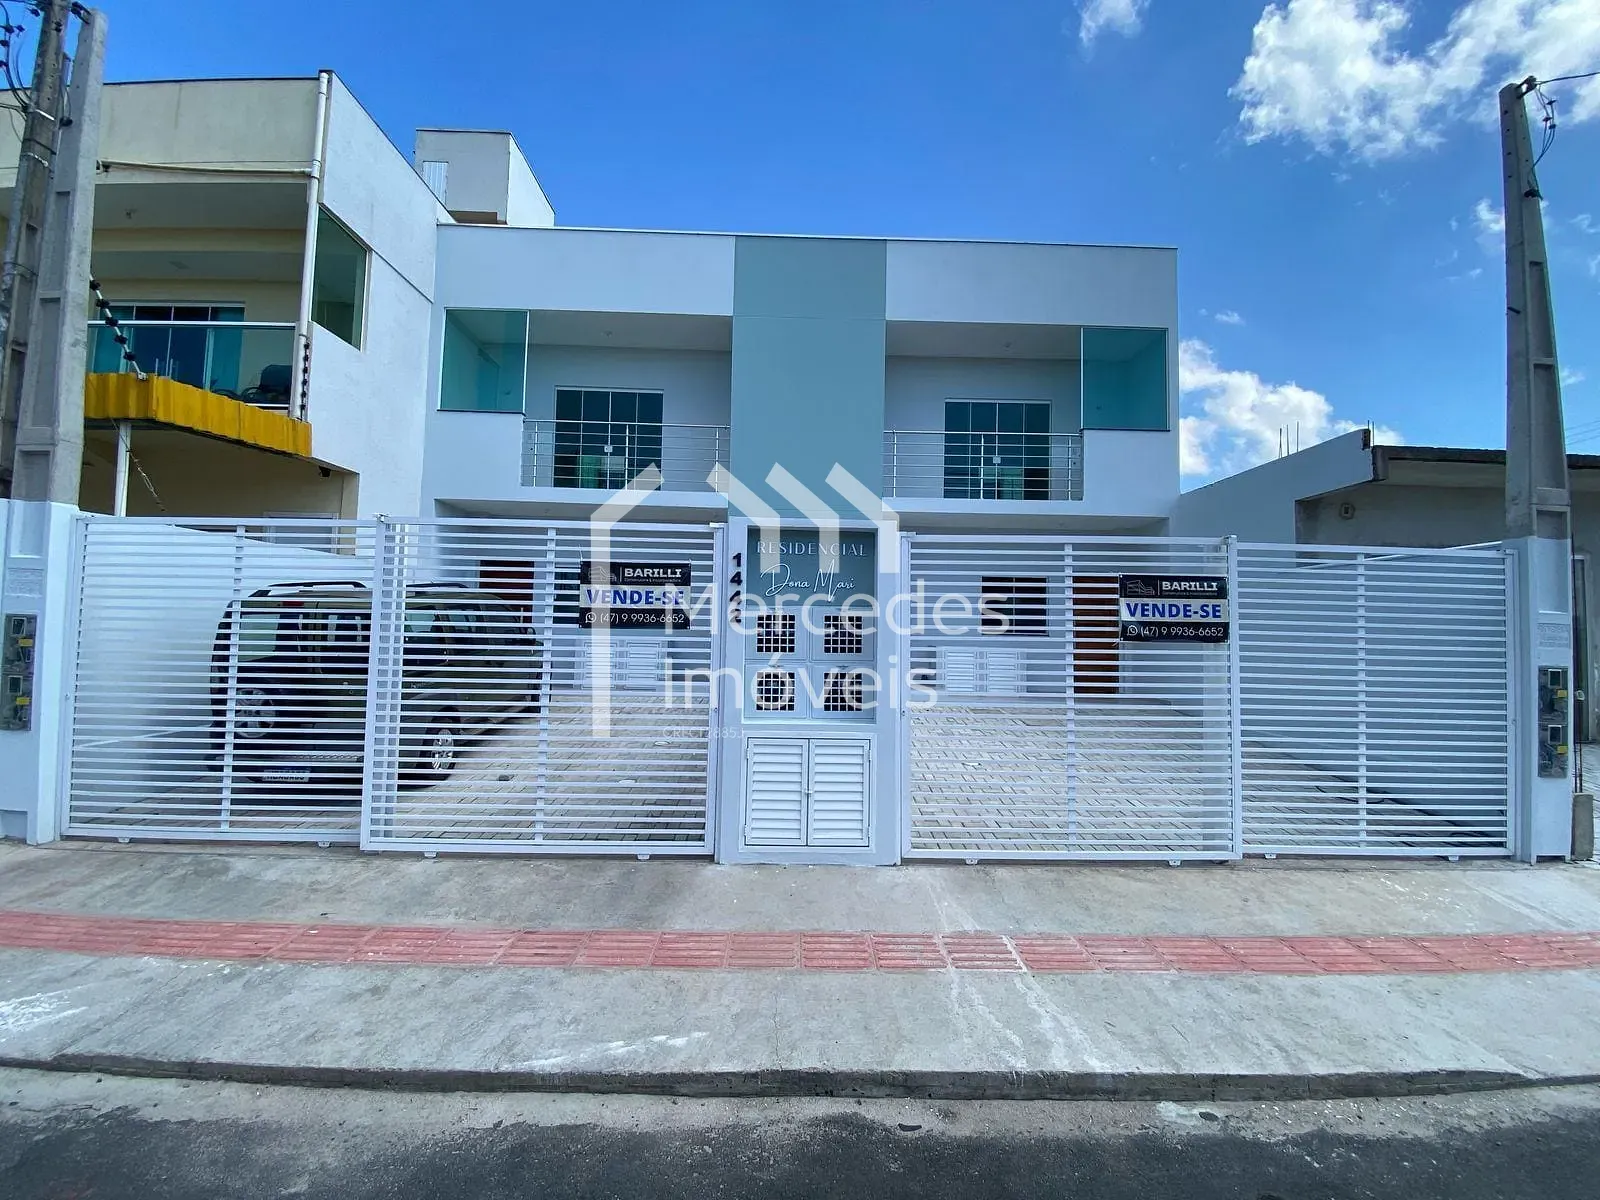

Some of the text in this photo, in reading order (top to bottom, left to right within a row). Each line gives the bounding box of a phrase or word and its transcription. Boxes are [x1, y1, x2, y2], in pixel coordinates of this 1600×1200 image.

[757, 541, 868, 556] RESIDENCIAL
[624, 567, 682, 577] BARILLI
[760, 559, 856, 602] Dona Mari
[1161, 581, 1218, 591] BARILLI
[586, 589, 684, 605] VENDE-SE
[1126, 602, 1222, 619] VENDE-SE
[600, 612, 685, 624] (47) 9 9936-6652
[1140, 627, 1224, 637] (47) 9 9936-6652
